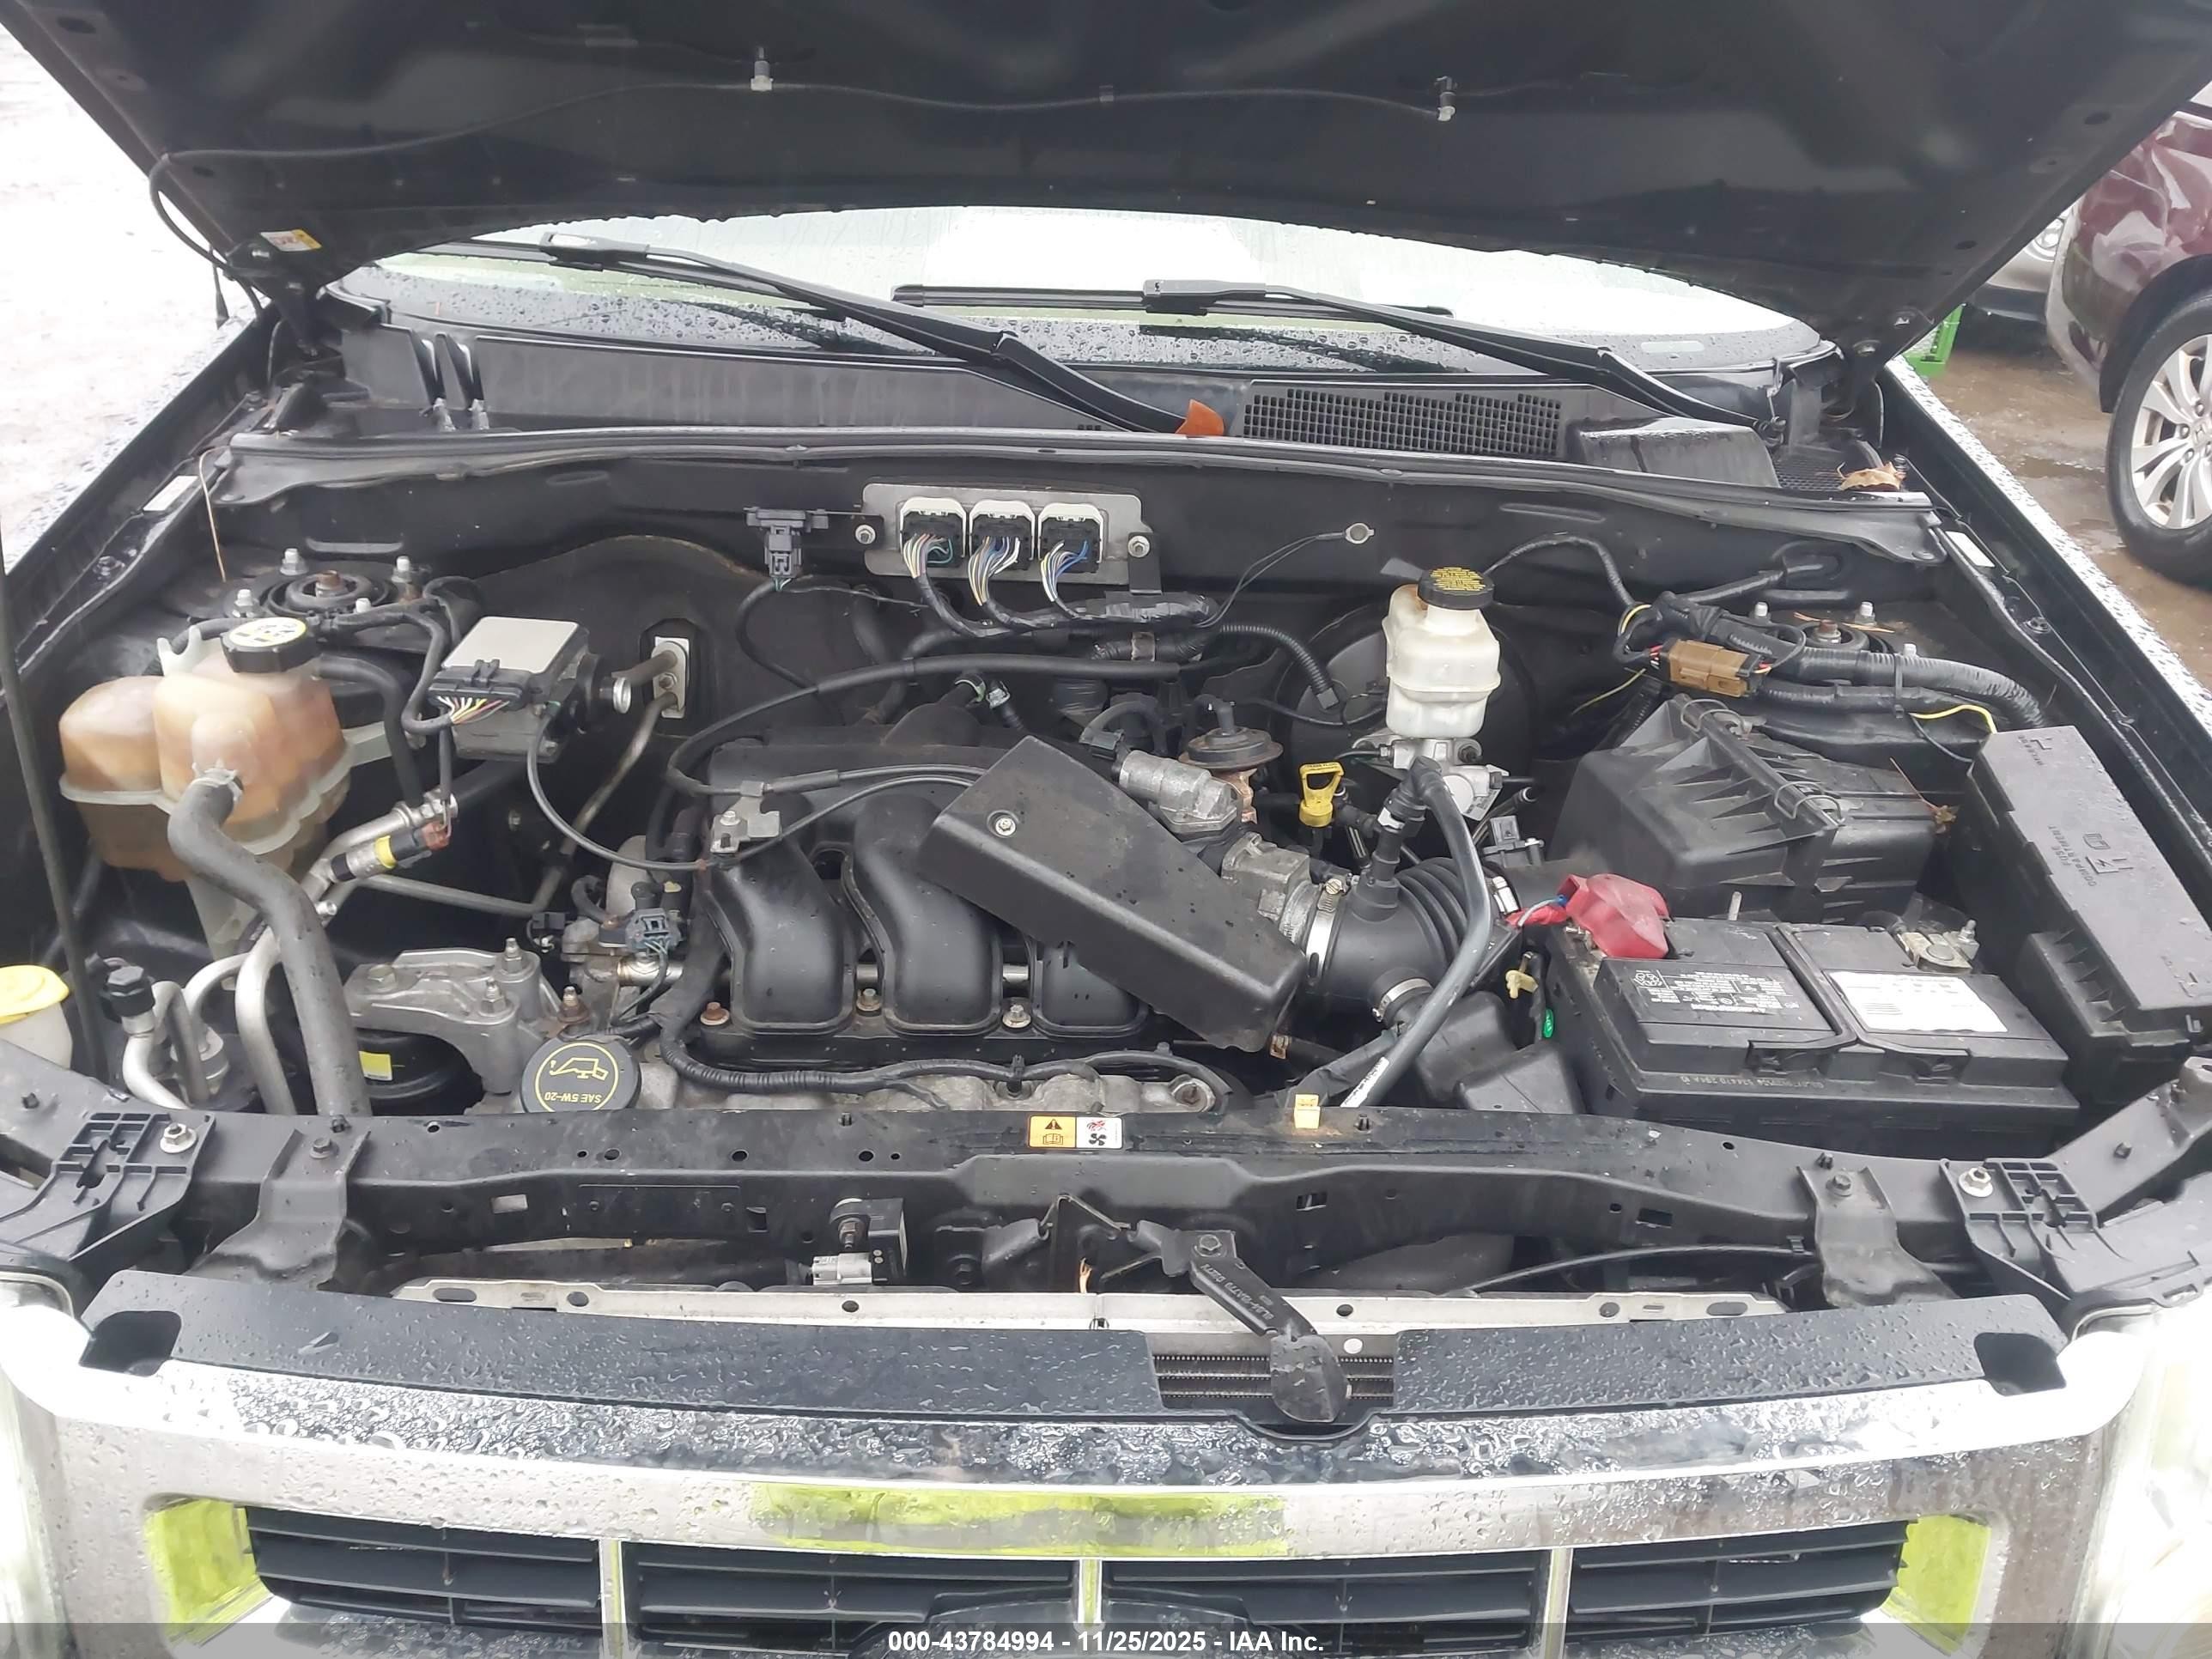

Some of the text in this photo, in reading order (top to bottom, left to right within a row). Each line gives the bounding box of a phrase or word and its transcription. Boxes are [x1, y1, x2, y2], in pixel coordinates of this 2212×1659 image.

[2048, 824, 2097, 886] COMPARTMENT
[544, 1091, 602, 1103] SAE 5W-20
